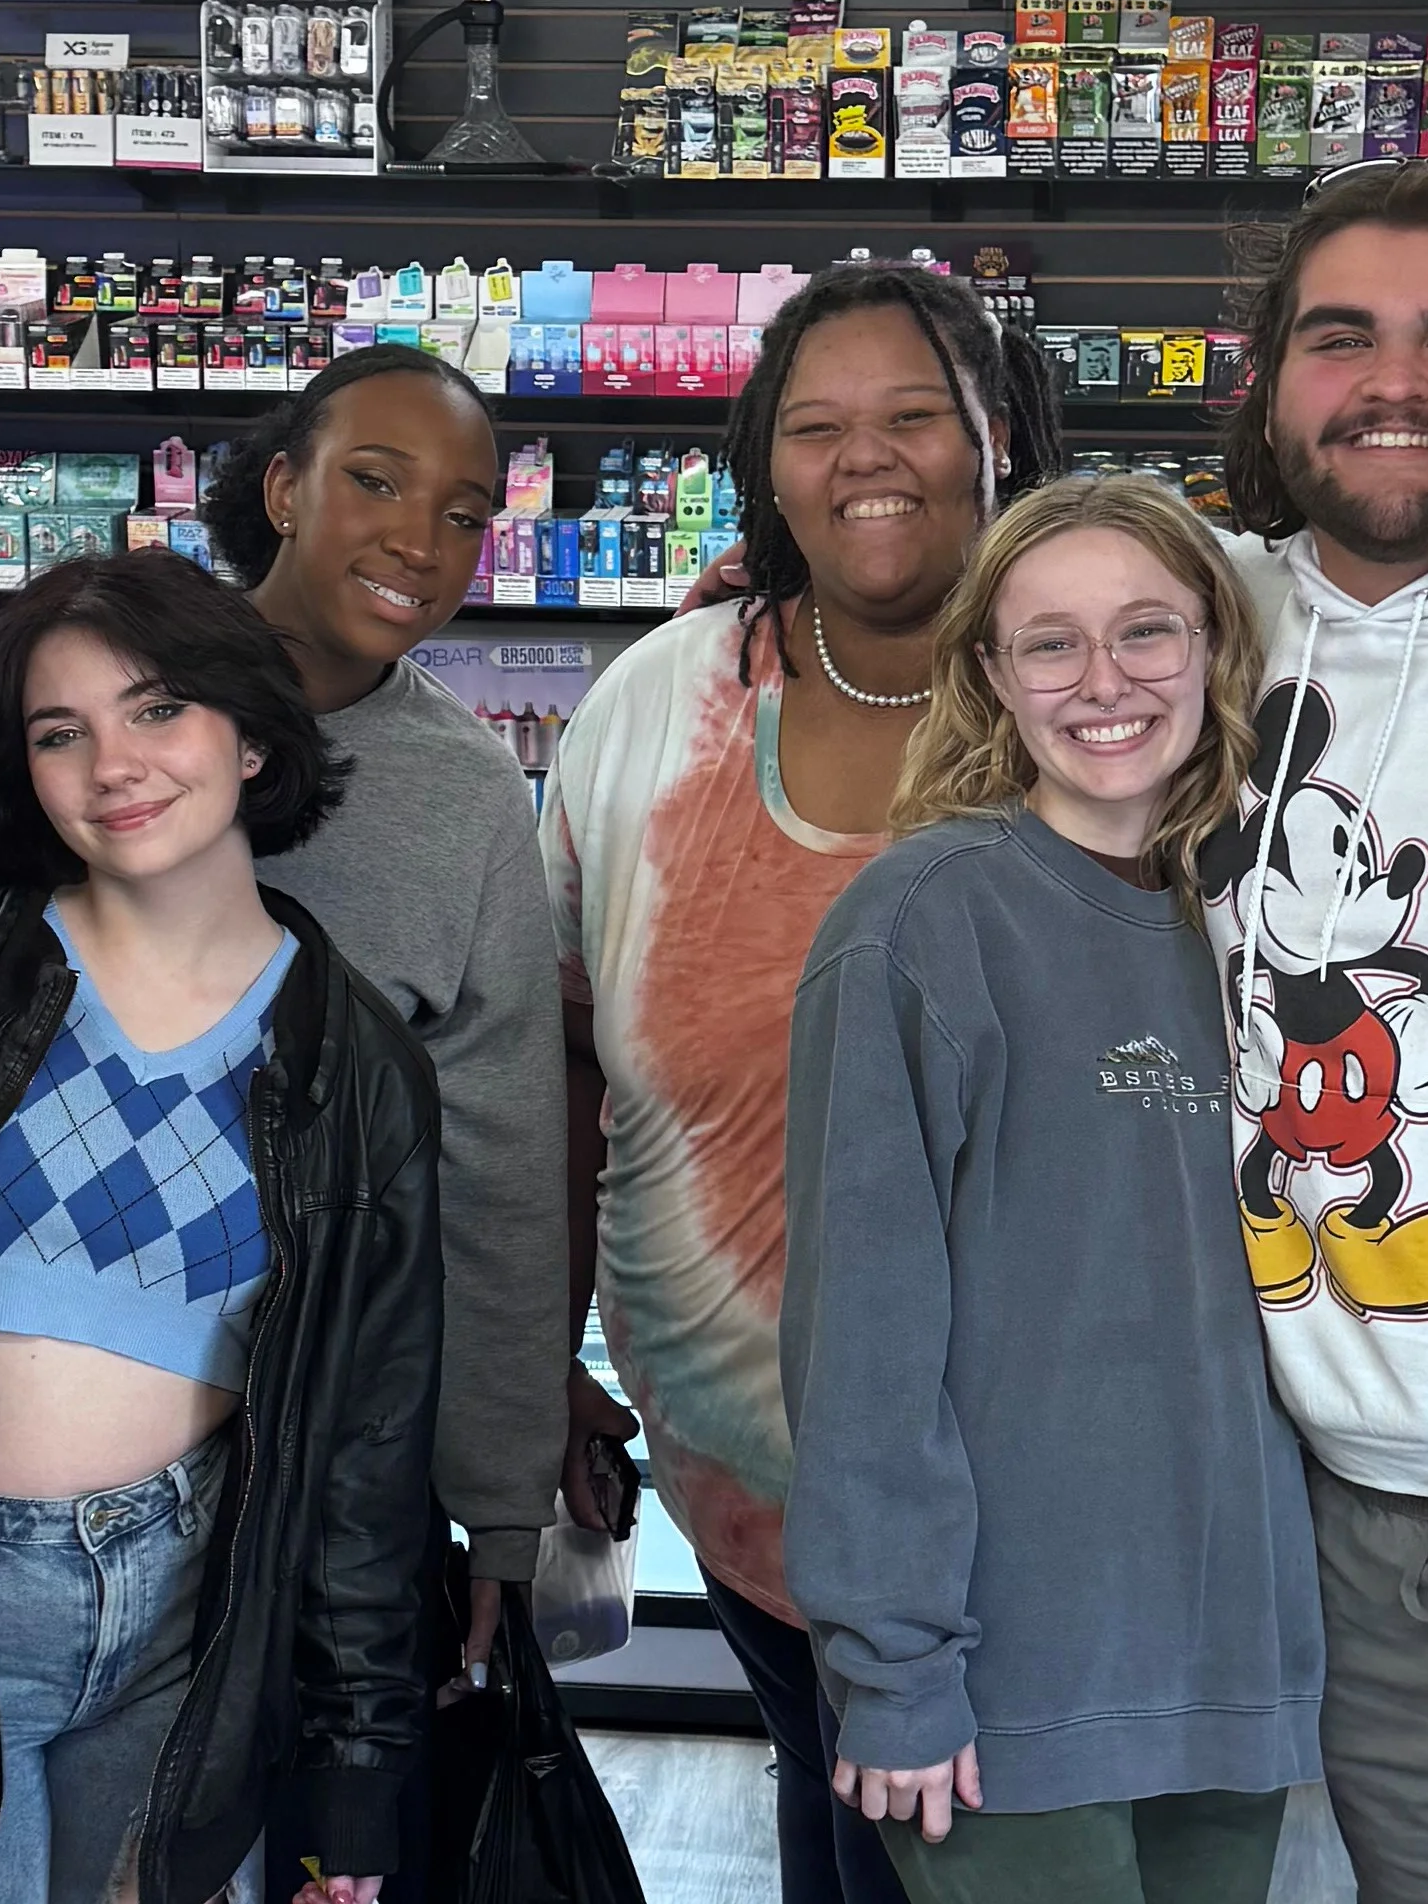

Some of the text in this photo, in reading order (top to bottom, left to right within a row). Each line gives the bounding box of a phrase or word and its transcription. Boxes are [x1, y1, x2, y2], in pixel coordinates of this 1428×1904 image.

[1175, 41, 1206, 55] LEAF
[1167, 109, 1200, 123] LEAF
[1217, 105, 1250, 119] LEAF
[1170, 128, 1200, 141] LEAF
[1218, 128, 1248, 142] LEAF
[544, 580, 575, 596] 3000
[501, 647, 554, 665] BR5000
[560, 655, 584, 664] COIL
